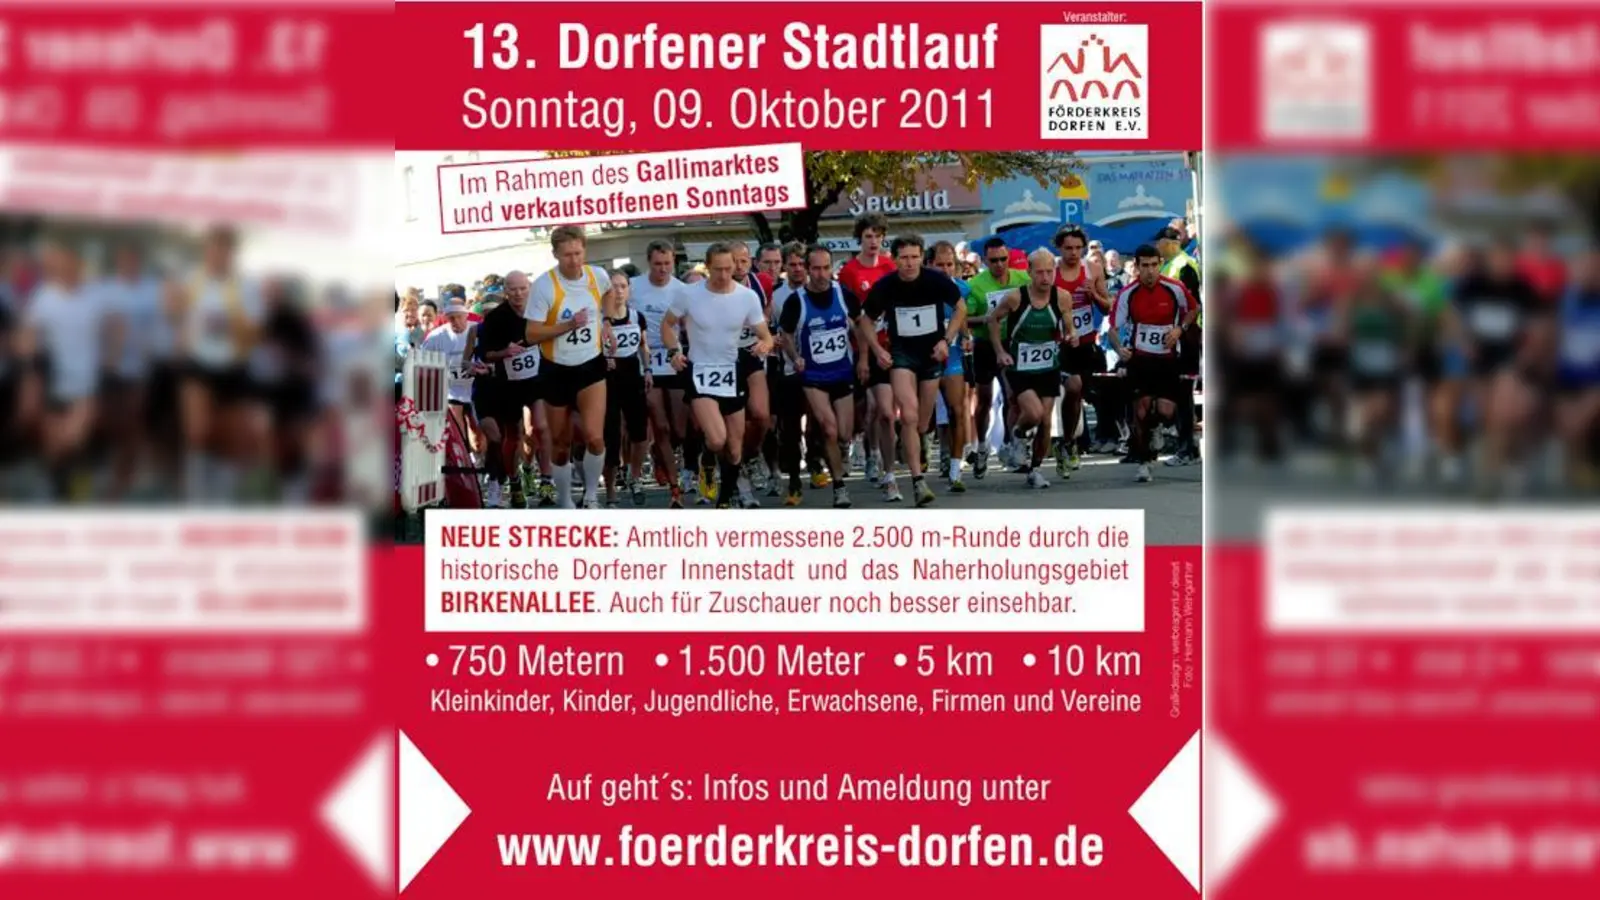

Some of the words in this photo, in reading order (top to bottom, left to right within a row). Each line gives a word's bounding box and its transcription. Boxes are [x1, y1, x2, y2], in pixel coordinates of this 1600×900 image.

[1064, 12, 1127, 23] Veranstalter:
[463, 23, 536, 69] 13.
[560, 23, 765, 69] Dorfener
[784, 22, 998, 69] Stadtlauf
[463, 88, 636, 137] Sonntag,
[654, 89, 712, 129] 09.
[731, 88, 885, 129] Oktober
[900, 89, 992, 128] 2011
[1049, 105, 1141, 118] FÖRDERKREIS
[1049, 120, 1105, 131] DORFEN
[1116, 120, 1141, 131] E.V.
[459, 172, 487, 195] Im
[495, 168, 584, 192] Rahmen
[592, 164, 629, 186] des
[637, 153, 779, 183] Gallimarktes
[454, 201, 493, 225] und
[501, 191, 678, 222] verkaufsoffenen
[686, 184, 789, 209] Sonntags
[849, 187, 951, 217] Sewald
[1065, 202, 1078, 223] P
[912, 314, 921, 327] 1
[566, 328, 592, 345] 43
[605, 332, 640, 349] 23
[812, 334, 847, 354] 243
[512, 355, 535, 372] 58
[1021, 347, 1052, 363] 120
[695, 371, 735, 387] 124
[442, 526, 500, 547] NEUE
[509, 525, 618, 547] STRECKE:
[627, 526, 707, 547] Amtlich
[716, 530, 845, 548] vermessene
[853, 526, 913, 548] 2.500
[923, 526, 1020, 548] m-Runde
[1030, 526, 1088, 548] durch
[1098, 526, 1129, 547] die
[442, 559, 558, 580] historische
[574, 559, 666, 580] Dorfener
[682, 559, 794, 580] Innenstadt
[809, 559, 847, 580] und
[863, 559, 899, 580] das
[914, 559, 1129, 586] Naherholungsgebiet
[442, 591, 600, 613] BIRKENALLEE.
[610, 592, 662, 613] Auch
[672, 592, 702, 613] für
[709, 592, 822, 613] Zuschauer
[830, 592, 881, 613] noch
[891, 592, 960, 613] besser
[968, 592, 1076, 613] einsehbar.
[450, 645, 505, 676] 750
[519, 645, 623, 676] Metern
[680, 645, 764, 676] 1.500
[778, 645, 865, 676] Meter
[918, 645, 934, 676] 5
[948, 645, 993, 676] km
[1049, 645, 1084, 676] 10
[1097, 645, 1141, 676] km
[430, 690, 554, 715] Kleinkinder,
[564, 690, 636, 715] Kinder,
[644, 690, 779, 717] Jugendliche,
[789, 690, 924, 715] Erwachsene,
[933, 689, 1005, 712] Firmen
[1015, 690, 1053, 712] und
[1062, 690, 1141, 712] Vereine
[547, 773, 591, 801] Auf
[705, 773, 768, 801] Infos
[781, 773, 827, 801] und
[838, 773, 971, 808] Ameldung
[984, 776, 1051, 801] unter
[497, 825, 1104, 868] www.foerderkreis-dorfen.de
